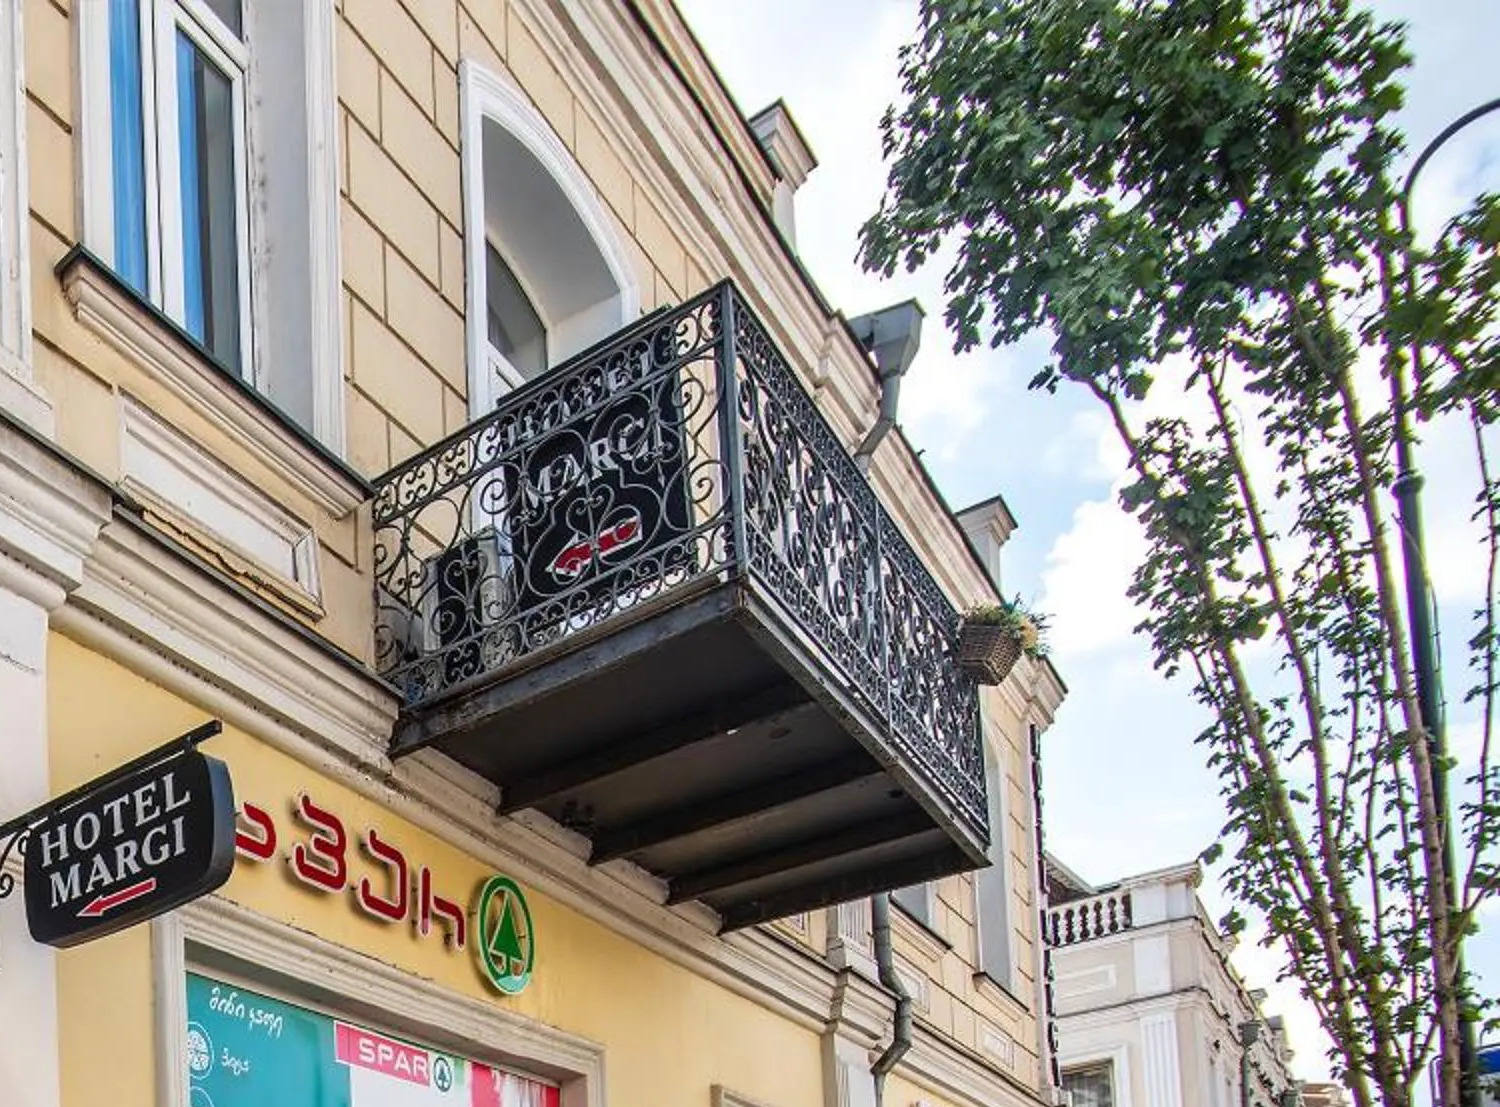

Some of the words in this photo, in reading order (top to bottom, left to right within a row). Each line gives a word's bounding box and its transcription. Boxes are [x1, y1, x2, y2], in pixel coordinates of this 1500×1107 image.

[40, 771, 192, 869] HOTEL
[49, 818, 188, 909] MARGI
[209, 987, 245, 1020] მინი
[248, 1008, 283, 1039] კაფე
[358, 1038, 428, 1077] SPAR
